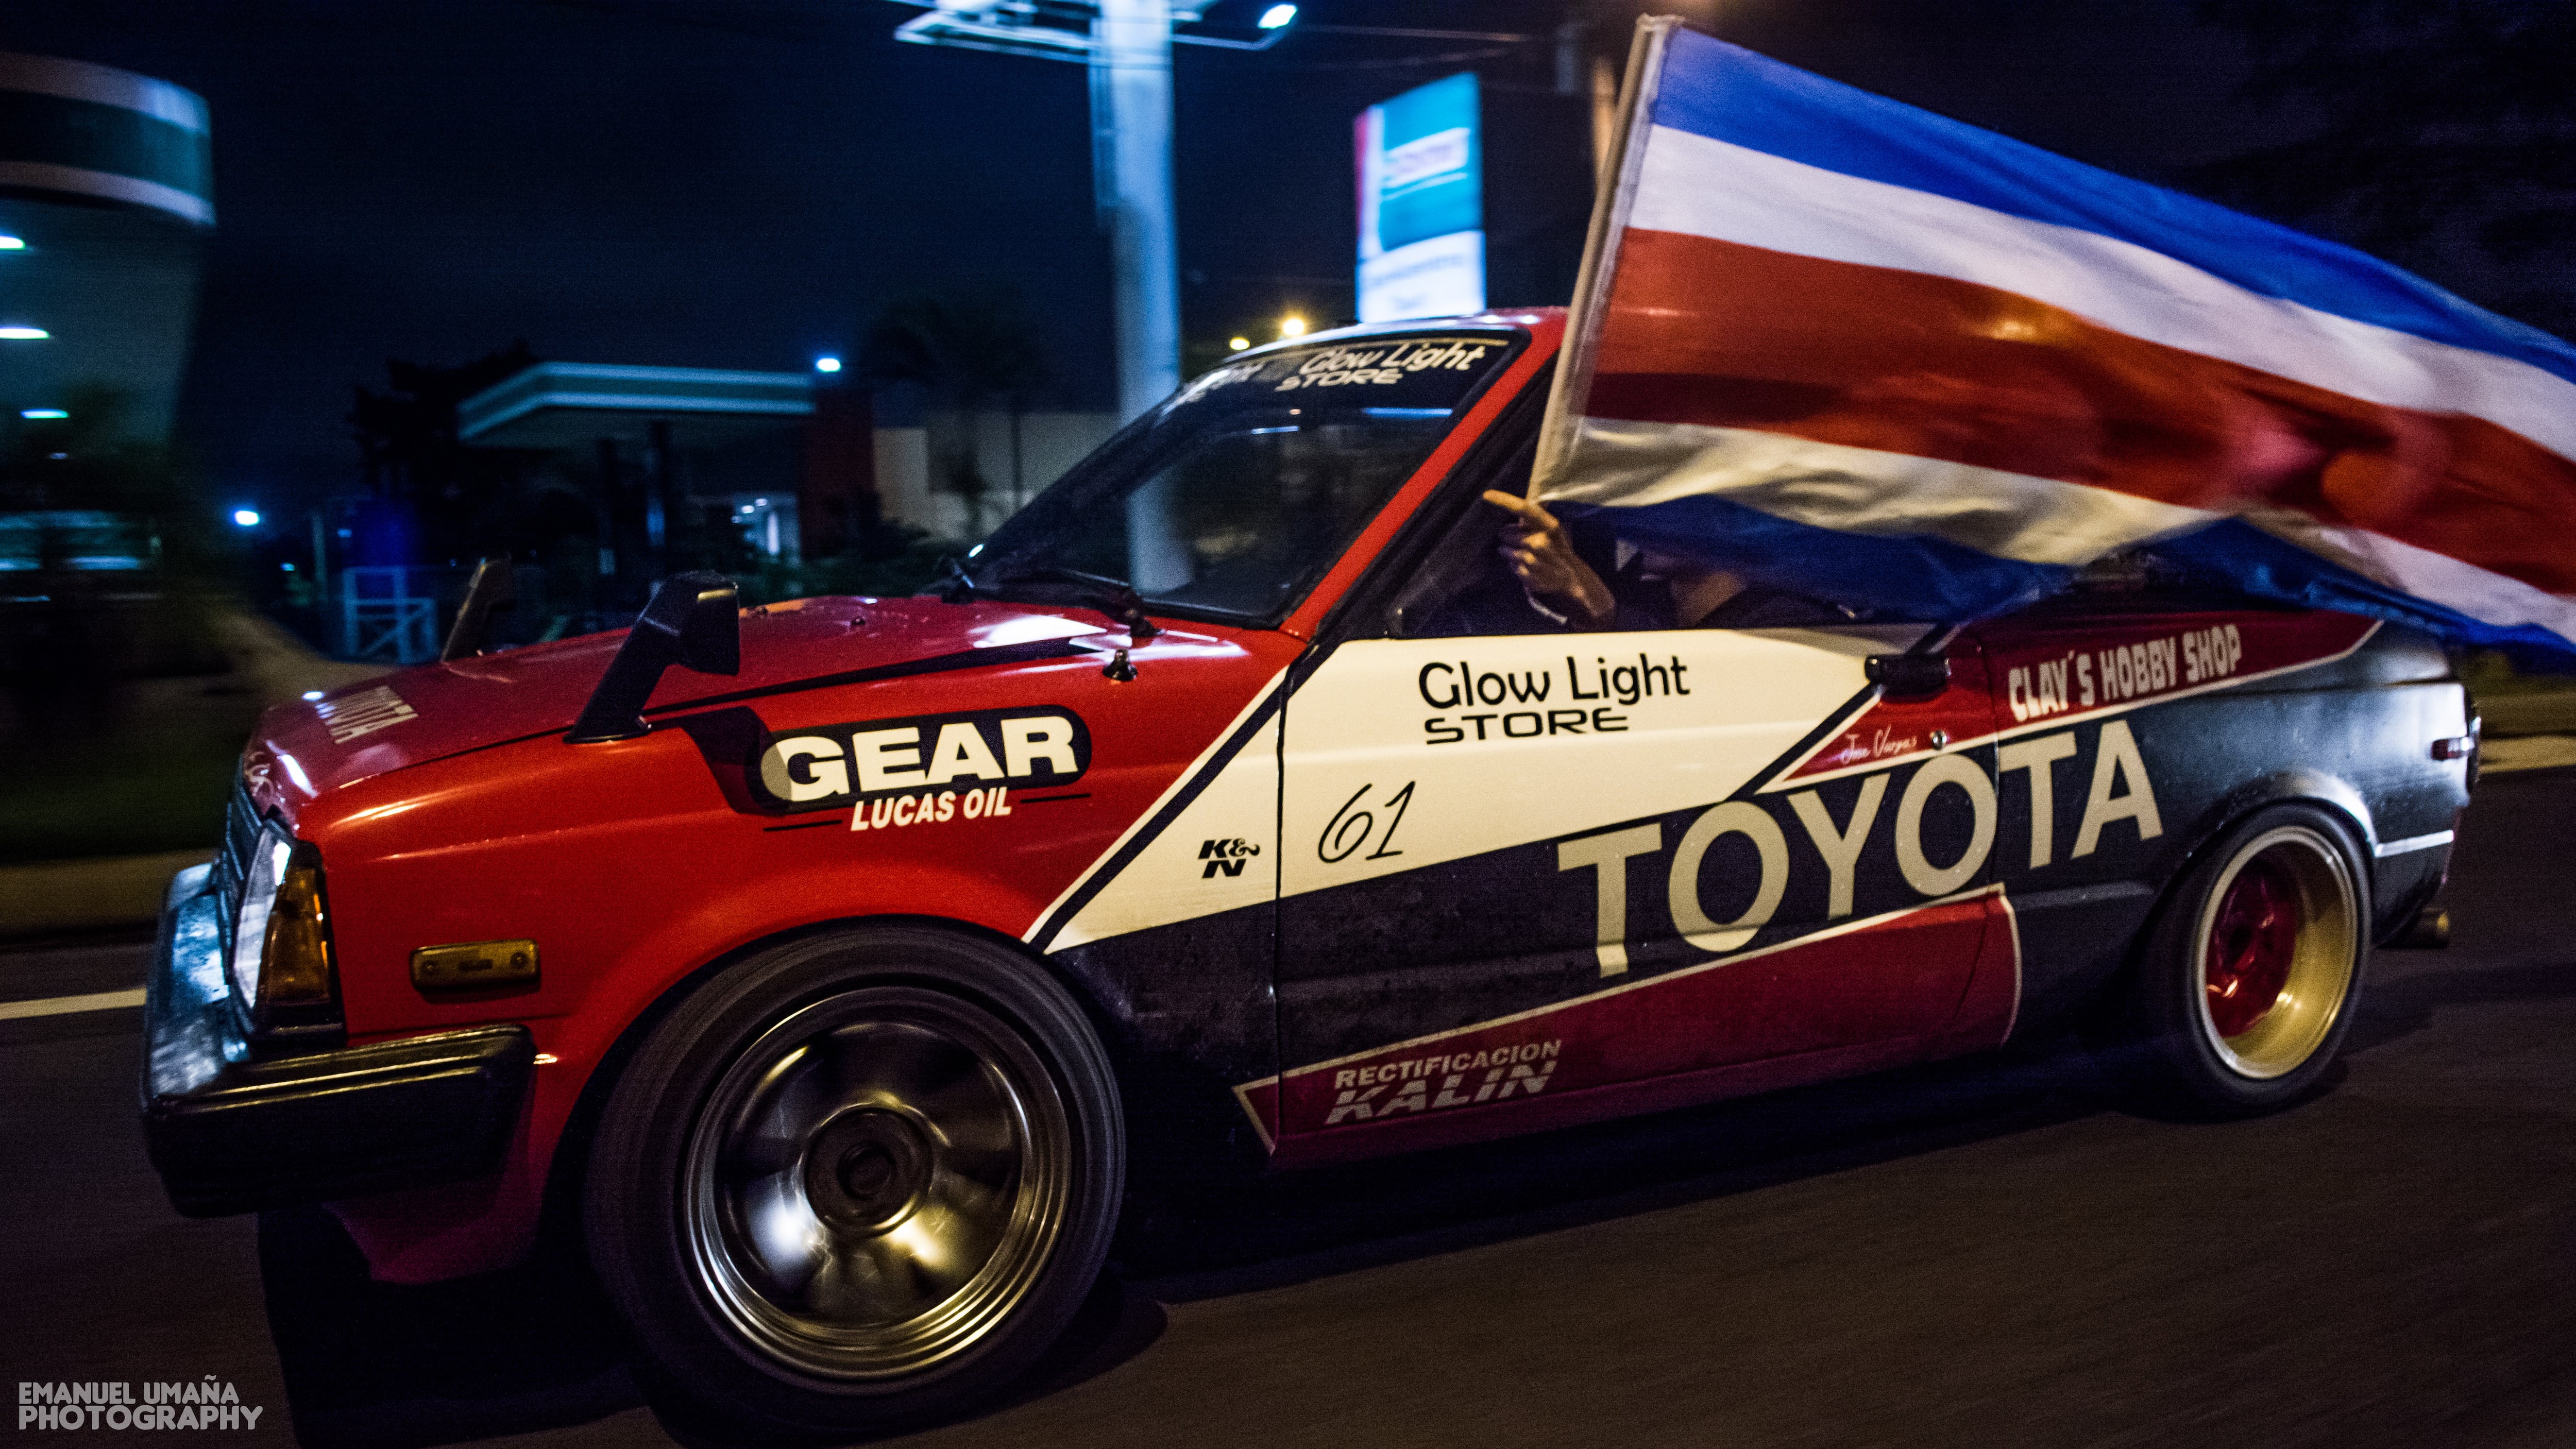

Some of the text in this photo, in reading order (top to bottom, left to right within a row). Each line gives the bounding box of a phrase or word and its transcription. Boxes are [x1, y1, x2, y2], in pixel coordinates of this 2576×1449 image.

[1274, 368, 1403, 393] STORE
[1299, 341, 1485, 376] Glow Light
[1418, 653, 1691, 709] Glow Light
[2098, 636, 2176, 702] HOBBY
[2182, 624, 2242, 683] SHOP
[315, 685, 419, 744] OTA
[1424, 707, 1629, 745] STORE
[760, 715, 1078, 802] GEAR
[850, 787, 1012, 831] LUCAS OIL
[1317, 780, 1416, 863] 61
[1557, 720, 2164, 979] TOYOTA
[1323, 1059, 1558, 1125] KALIN
[1334, 1039, 1563, 1089] RECTIFICACION
